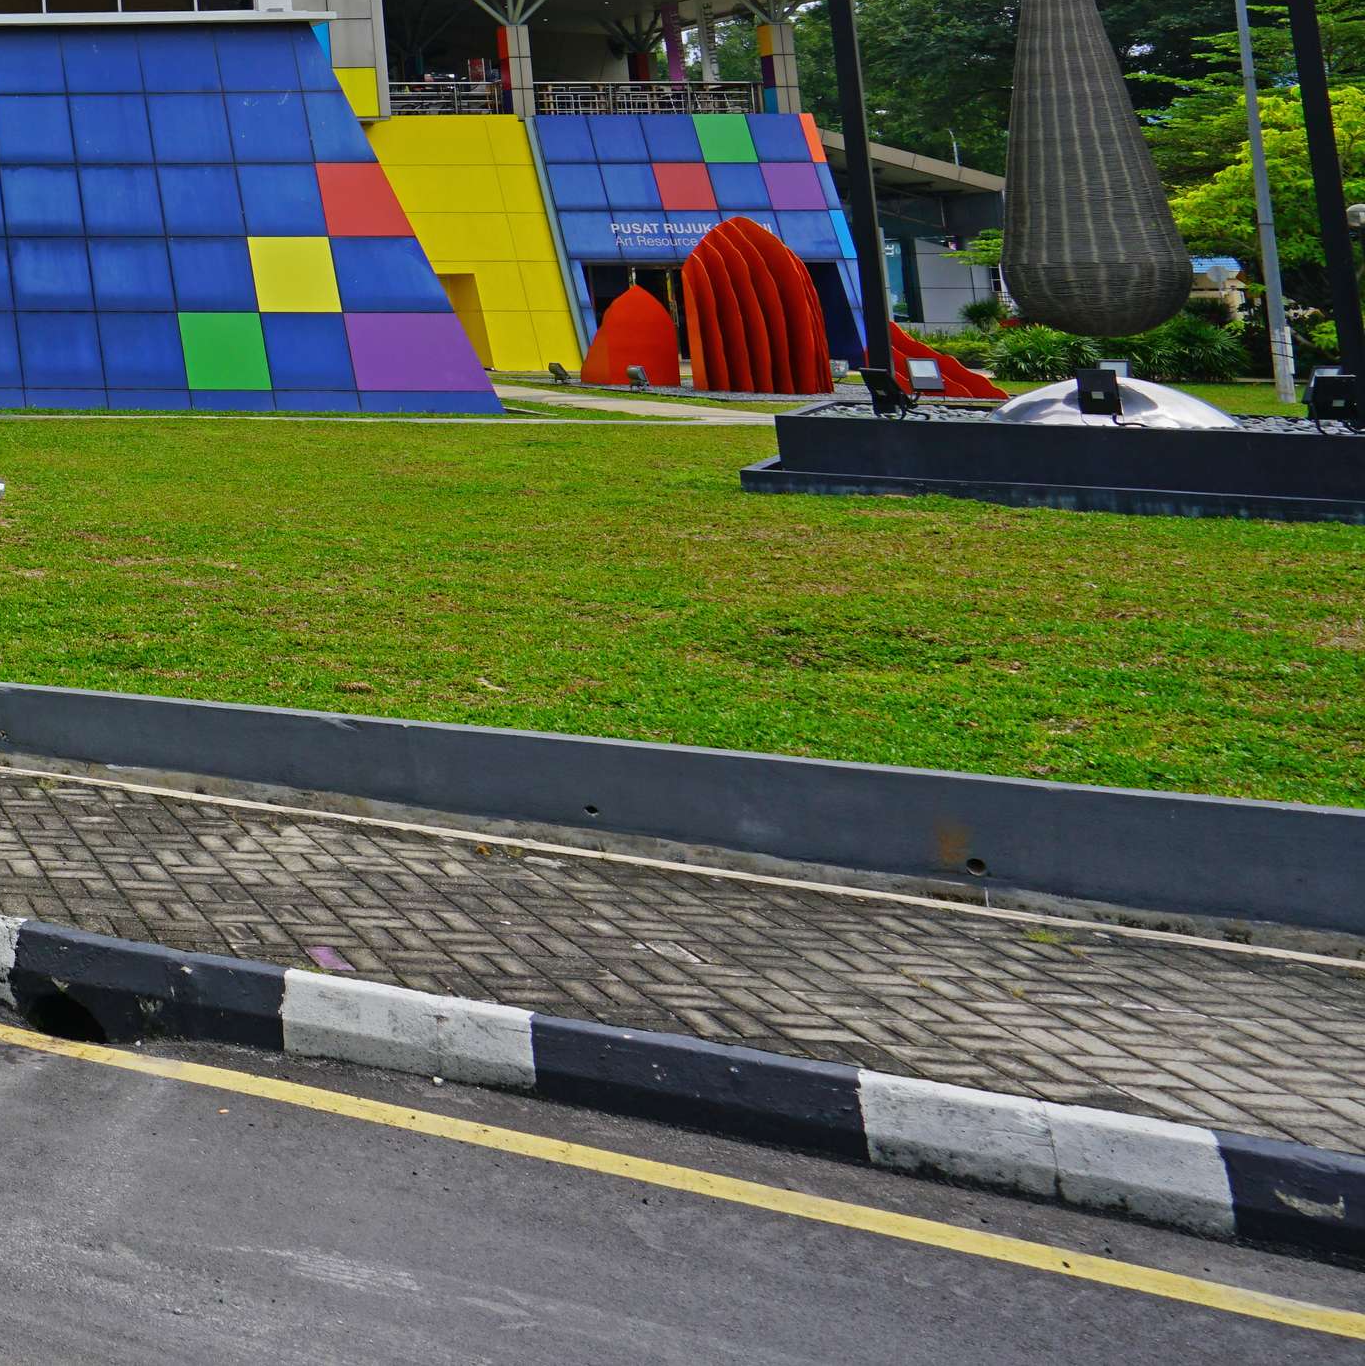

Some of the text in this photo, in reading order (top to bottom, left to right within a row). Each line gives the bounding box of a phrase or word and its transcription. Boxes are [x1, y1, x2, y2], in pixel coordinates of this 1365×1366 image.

[610, 223, 718, 234] PUSAT RUJUK
[615, 236, 698, 247] Art Resource
